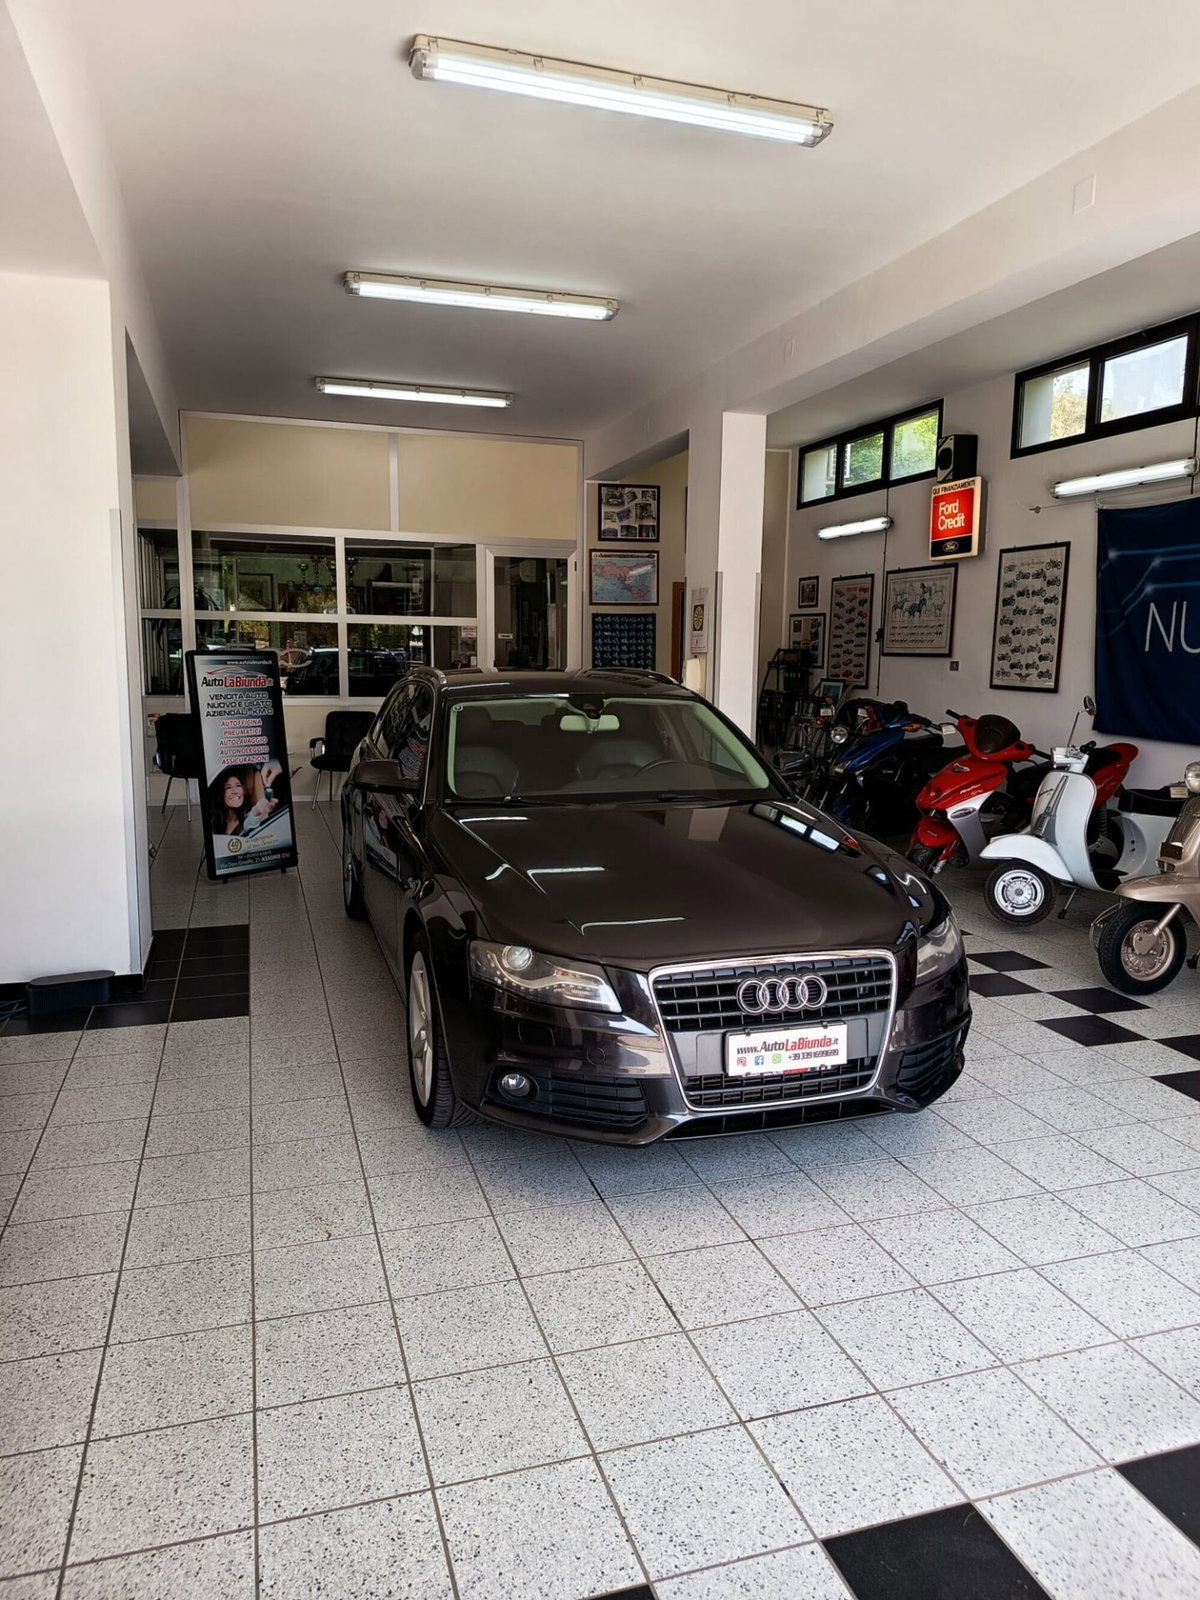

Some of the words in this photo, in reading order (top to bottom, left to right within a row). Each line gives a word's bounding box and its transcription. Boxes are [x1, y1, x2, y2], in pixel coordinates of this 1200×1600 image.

[932, 486, 941, 495] QUI
[938, 499, 959, 516] Ford
[937, 513, 965, 531] Credit
[208, 693, 244, 701] VENDITA
[245, 692, 269, 700] AUTO
[244, 700, 272, 708] USATO
[220, 719, 262, 727] AUTOFFICINA
[223, 728, 262, 736] PNEUMATICI
[219, 736, 268, 746] AUTOLAVAGGIO
[219, 746, 269, 755] AUTONOLEGGIO
[221, 756, 269, 765] ASSICURAZIONI
[261, 854, 281, 862] ASSORO
[737, 1035, 839, 1054] www.AutoLaBiunda.it
[788, 1053, 800, 1061] +39
[800, 1052, 813, 1060] 339
